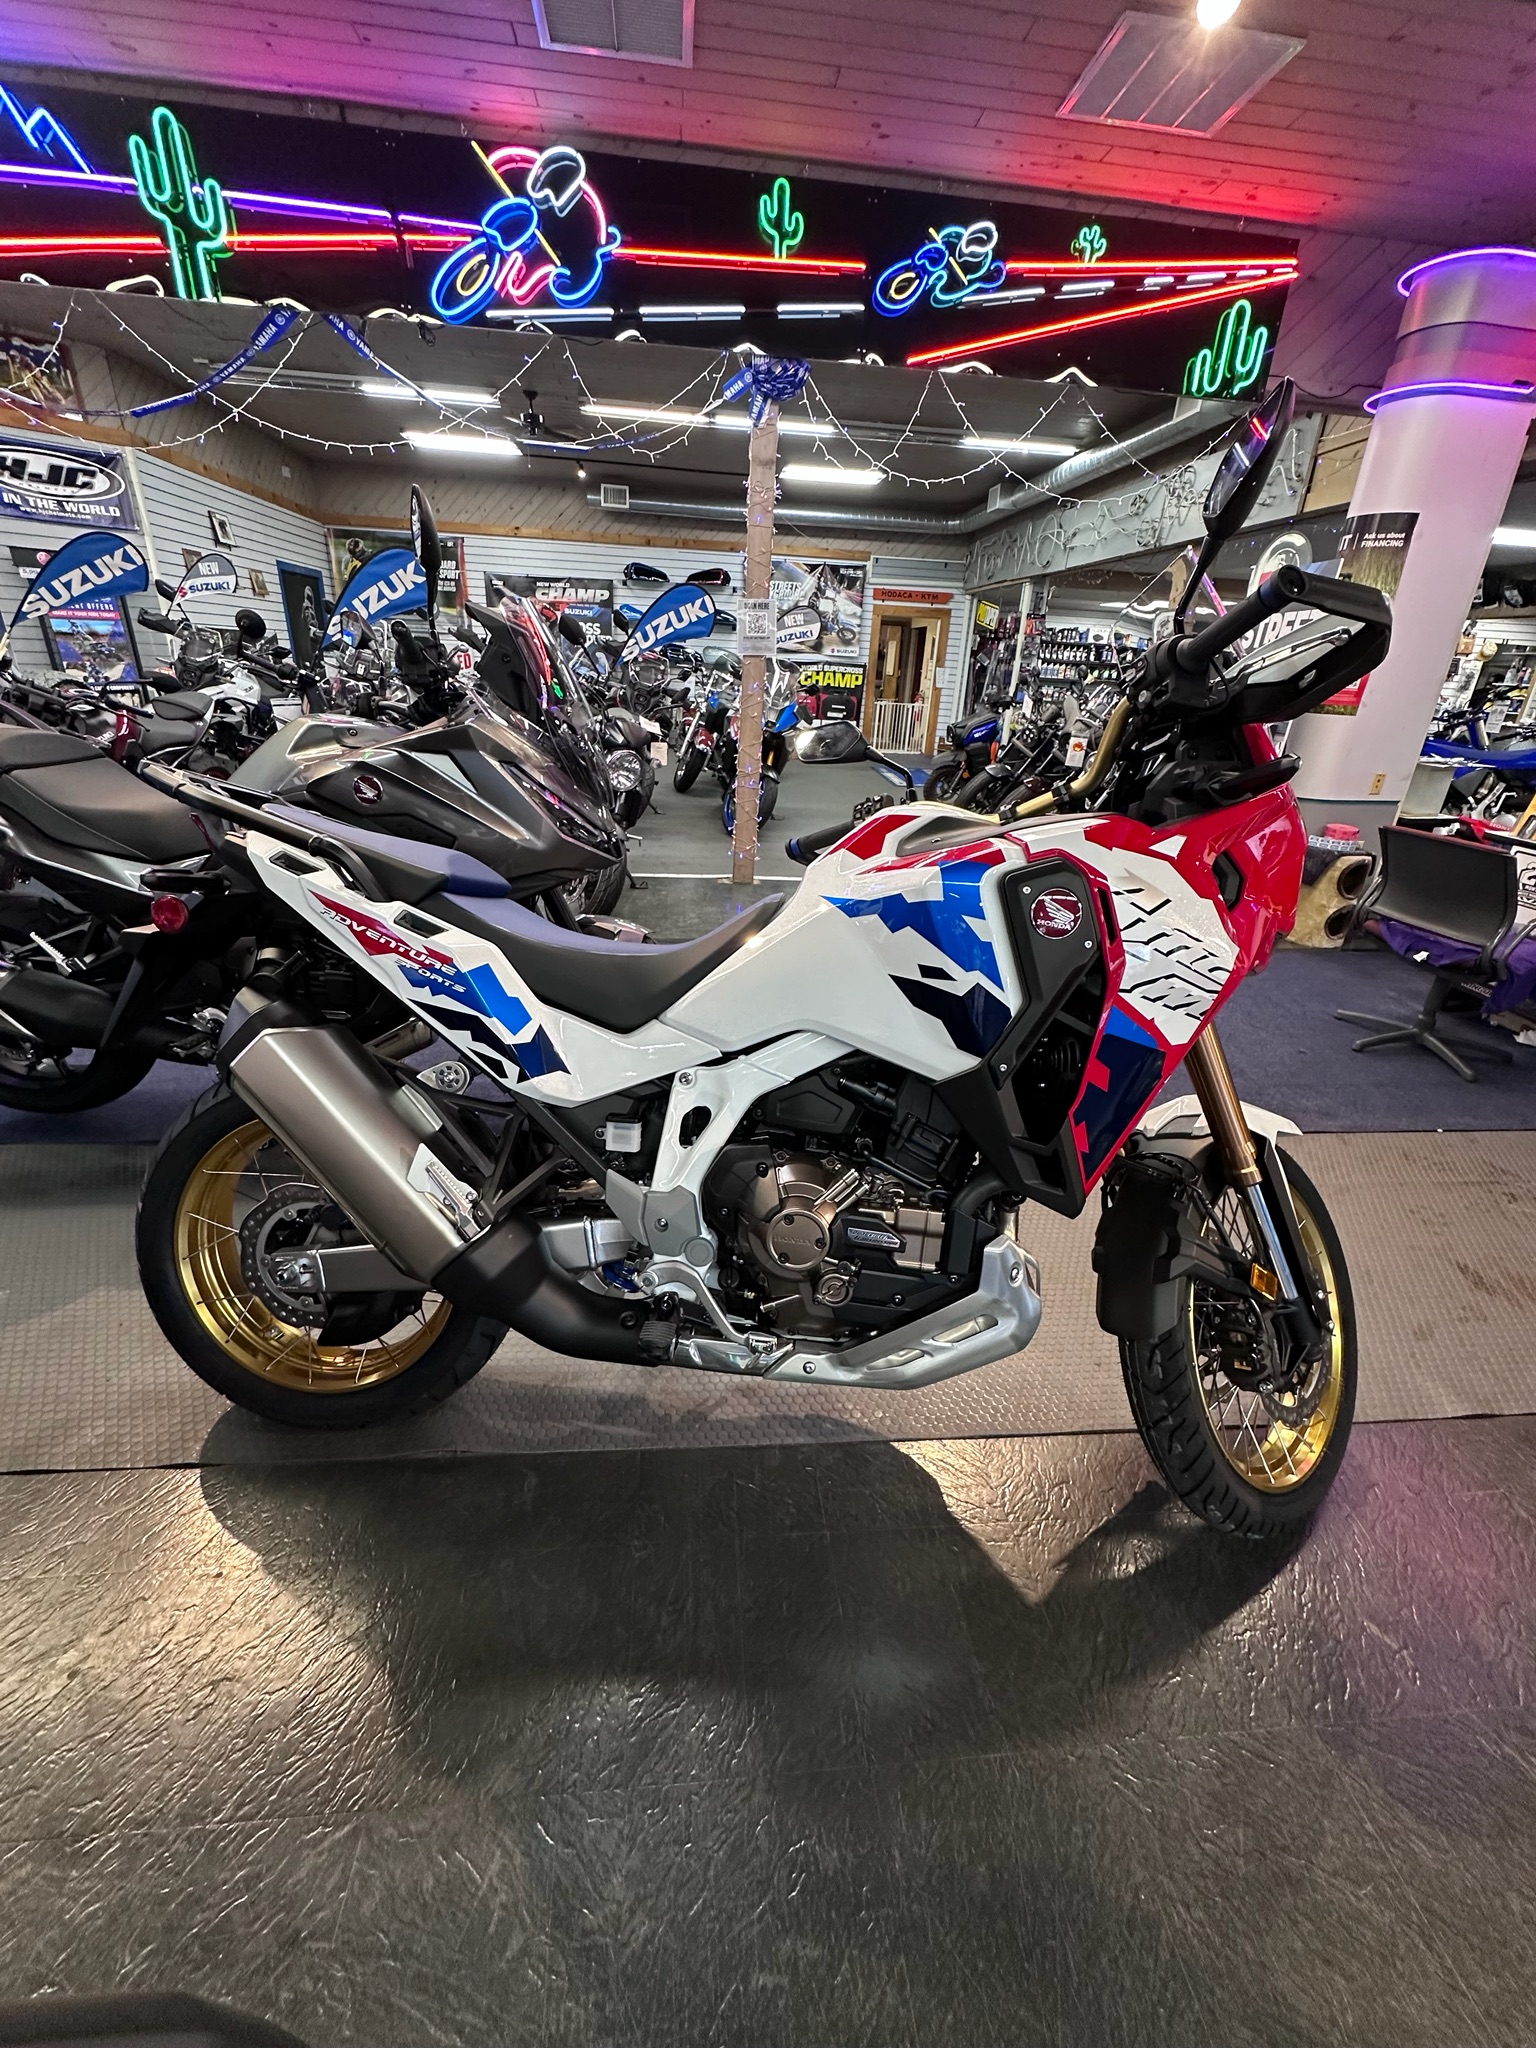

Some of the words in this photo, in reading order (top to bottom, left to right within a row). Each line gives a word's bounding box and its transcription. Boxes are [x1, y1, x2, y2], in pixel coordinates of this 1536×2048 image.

[329, 314, 344, 331] AHA
[254, 323, 278, 350] YAMAHA
[355, 338, 374, 357] YAMA
[220, 357, 246, 377] YAMAHA
[723, 380, 744, 401] MAHA
[750, 395, 764, 421] AMAH
[0, 456, 98, 490] HJC
[2, 492, 23, 505] IN
[25, 497, 59, 511] THE
[63, 501, 120, 517] WORLD
[1361, 540, 1405, 548] FINANCING
[198, 561, 220, 576] NEW
[439, 569, 460, 580] SPORT
[21, 544, 145, 619] SUZUKI
[188, 581, 231, 594] SUZUKI
[326, 560, 427, 642] SUZUK
[535, 588, 610, 603] CHAMP
[564, 607, 593, 616] SUZUKI
[784, 613, 805, 628] NEW
[621, 594, 715, 662] SUZUKI
[776, 630, 814, 645] SUZUKI
[823, 665, 864, 674] SUPERCROSS
[800, 671, 863, 688] CHAMP
[1036, 919, 1073, 931] HONDA
[320, 907, 458, 976] ADVENTURE
[394, 958, 467, 994] SPORTS
